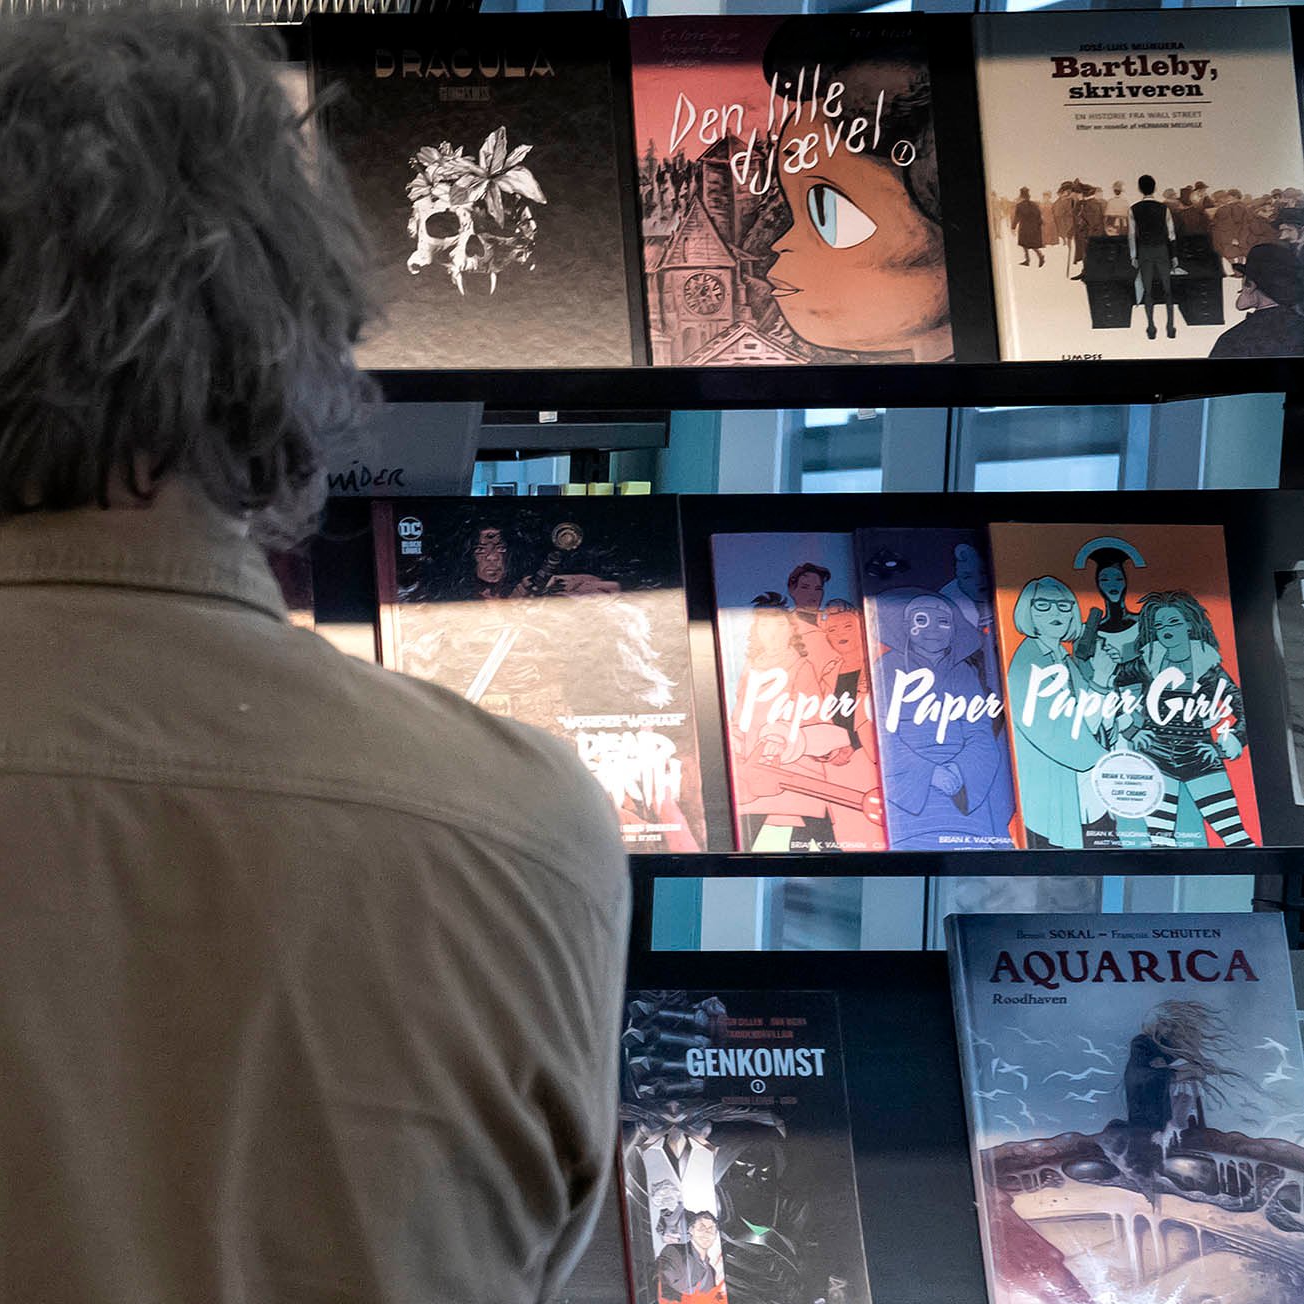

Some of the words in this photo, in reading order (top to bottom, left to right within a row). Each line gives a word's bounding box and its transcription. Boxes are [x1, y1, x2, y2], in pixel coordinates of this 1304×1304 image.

[374, 49, 557, 79] DRACULA
[1051, 55, 1218, 81] Bartleby,
[1069, 81, 1204, 99] skriveren
[669, 92, 744, 156] Den
[766, 63, 846, 136] lille
[739, 664, 859, 742] Paper
[886, 667, 1004, 745] Paper
[1049, 929, 1096, 940] SOKAL
[1152, 928, 1221, 939] SCHUITEN
[990, 949, 1260, 990] AQUARICA
[991, 993, 1068, 1006] Roodhaven
[685, 1047, 826, 1077] GENKOMST
